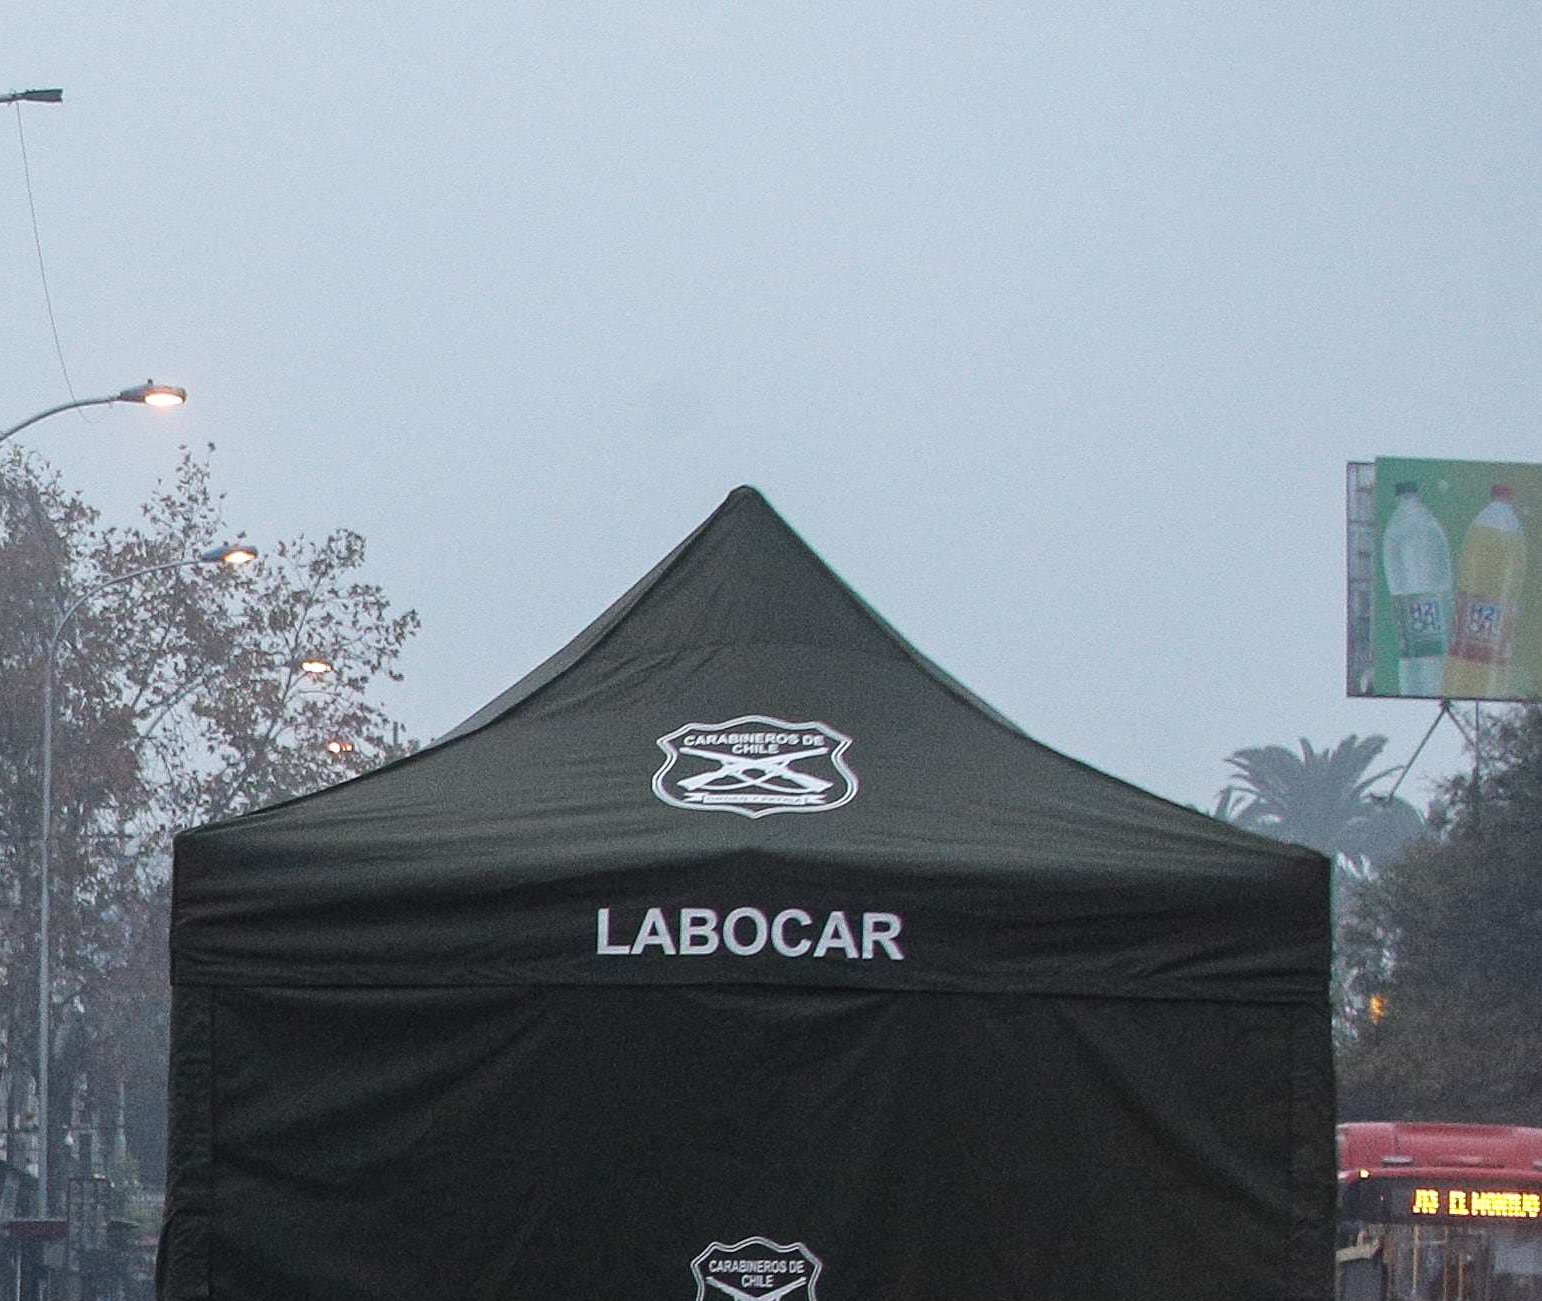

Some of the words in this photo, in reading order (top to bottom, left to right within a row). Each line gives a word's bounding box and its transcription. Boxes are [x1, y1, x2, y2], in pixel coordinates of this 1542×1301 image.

[683, 733, 799, 747] CARABINEROS
[802, 735, 826, 746] DE
[731, 743, 780, 755] CHILE
[596, 906, 905, 960] LABOCAR
[708, 1260, 788, 1273] CARABINEROS
[789, 1261, 805, 1273] DE
[741, 1275, 774, 1288] CHILE
